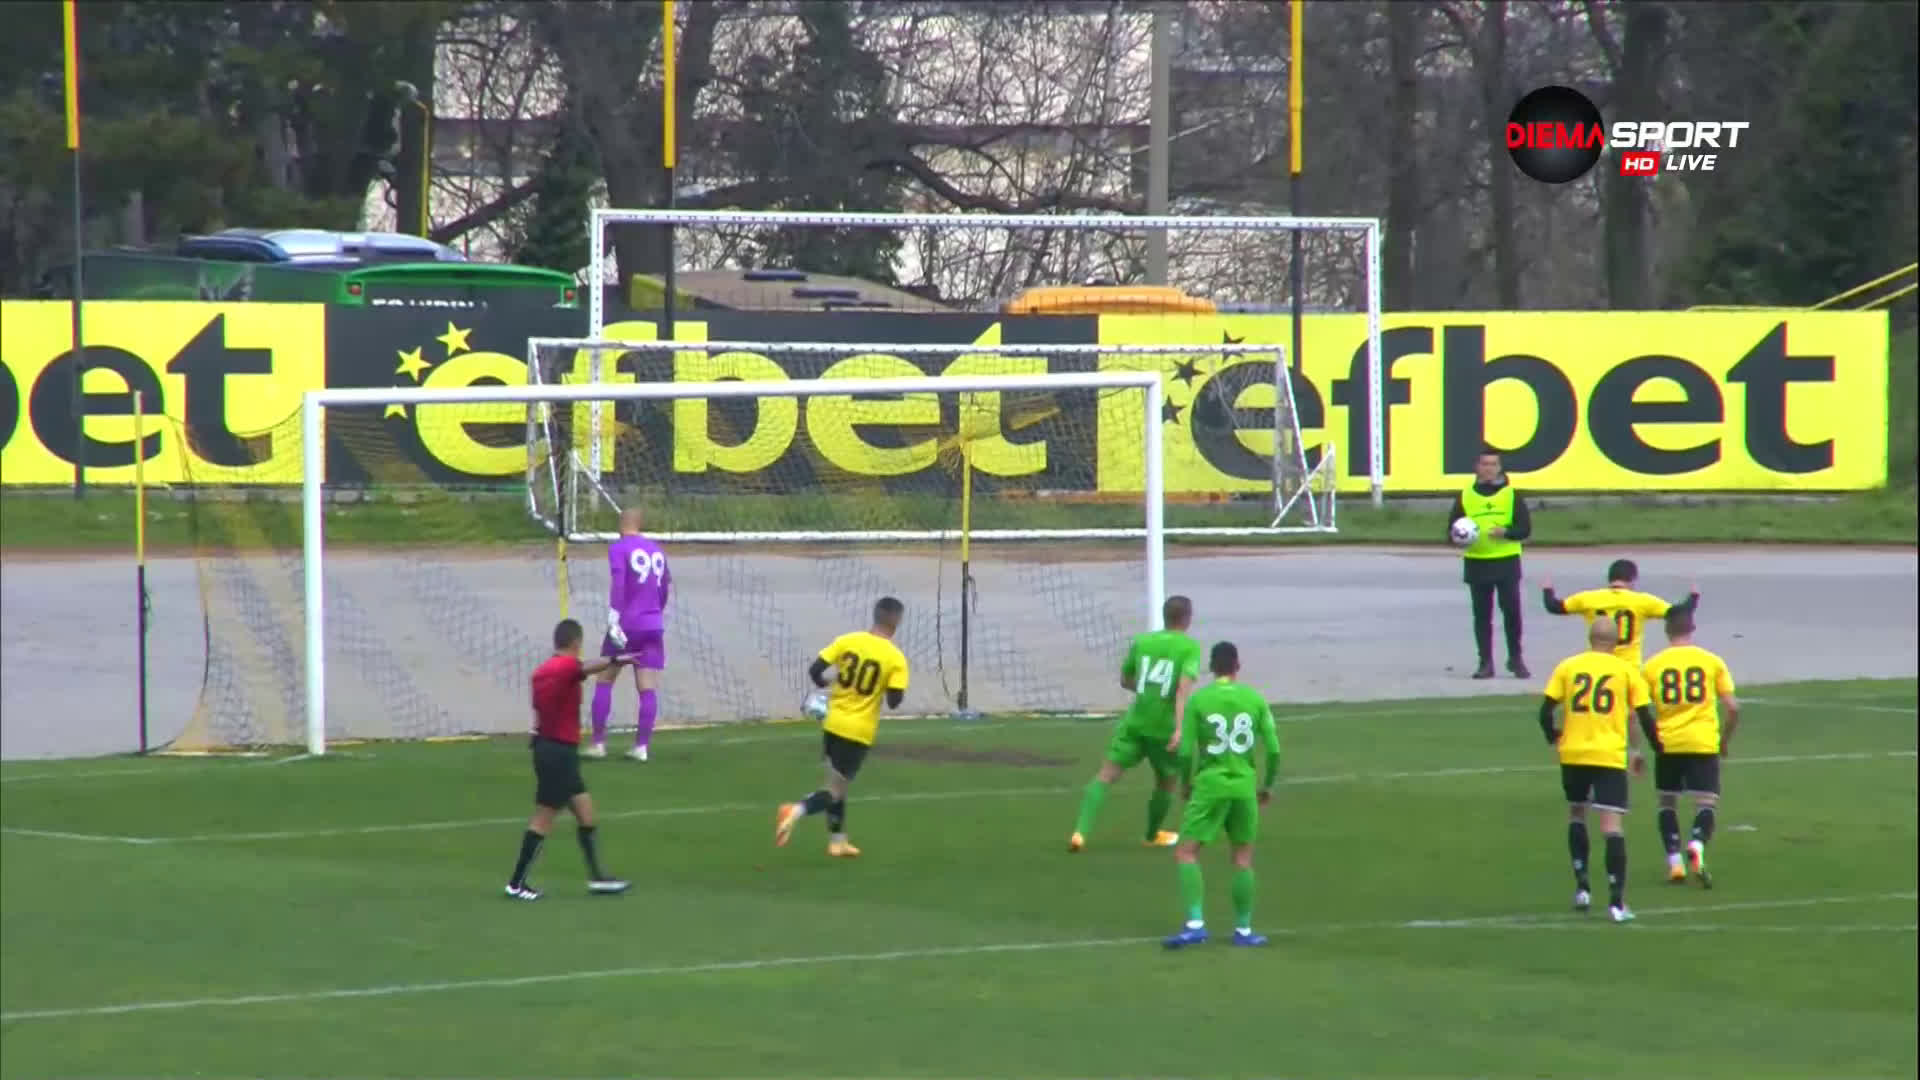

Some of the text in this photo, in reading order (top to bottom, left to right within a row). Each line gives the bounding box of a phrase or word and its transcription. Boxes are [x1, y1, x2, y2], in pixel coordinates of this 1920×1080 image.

[0, 313, 272, 467] et
[415, 320, 1047, 476] efbet
[1189, 321, 1836, 481] efbet
[630, 549, 666, 586] 99
[1599, 609, 1636, 646] 0
[838, 651, 880, 696] 30
[1136, 656, 1174, 697] 14
[1571, 672, 1614, 715] 26
[1660, 667, 1706, 705] 88
[1206, 712, 1255, 755] 38
